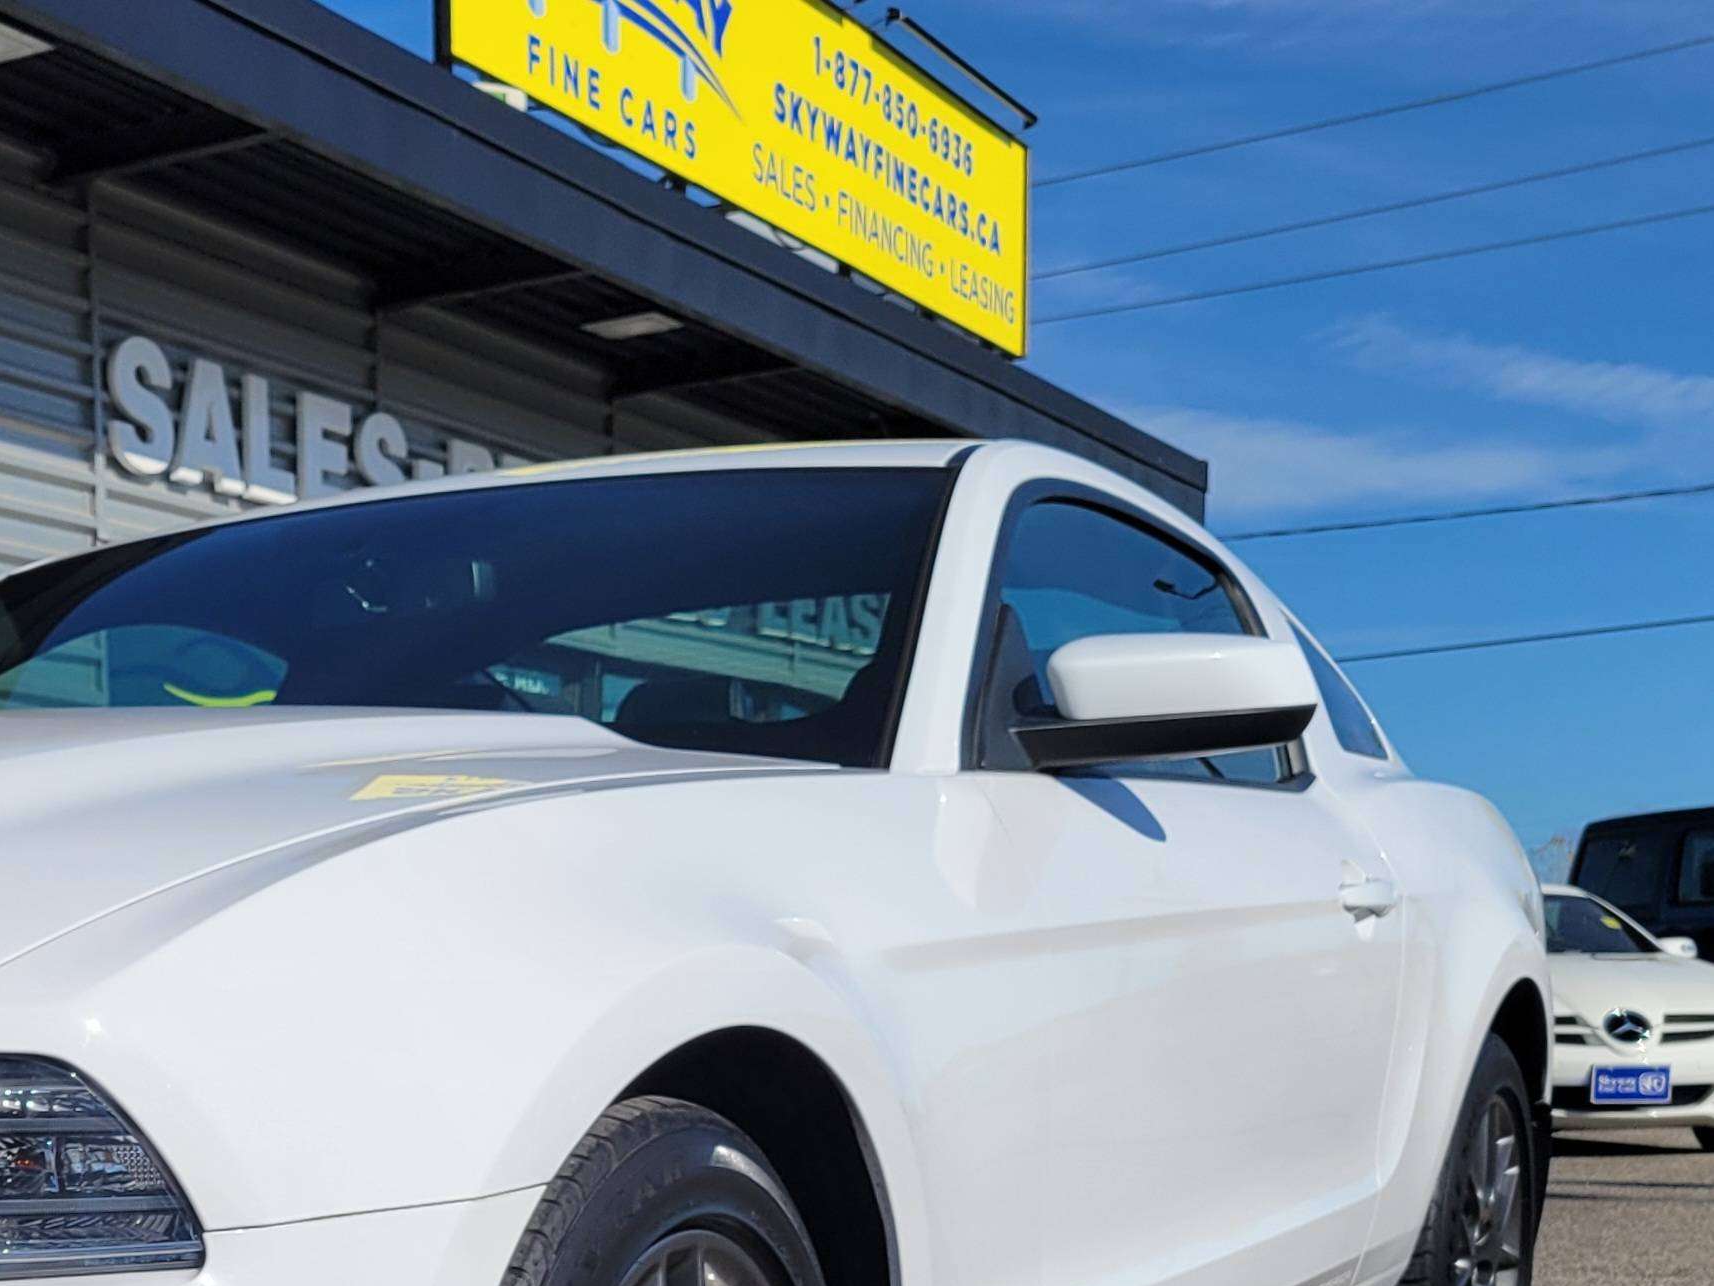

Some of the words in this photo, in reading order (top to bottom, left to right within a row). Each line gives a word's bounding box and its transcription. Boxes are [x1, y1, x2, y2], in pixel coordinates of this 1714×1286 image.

[527, 34, 601, 111] FINE
[619, 86, 697, 160] CARS
[774, 82, 1003, 256] SKYWAYFINECARS.CA
[813, 36, 974, 177] 1-877-850-6936
[752, 142, 817, 212] SALES
[837, 190, 934, 278] FINANCING
[949, 257, 1016, 325] LEASING
